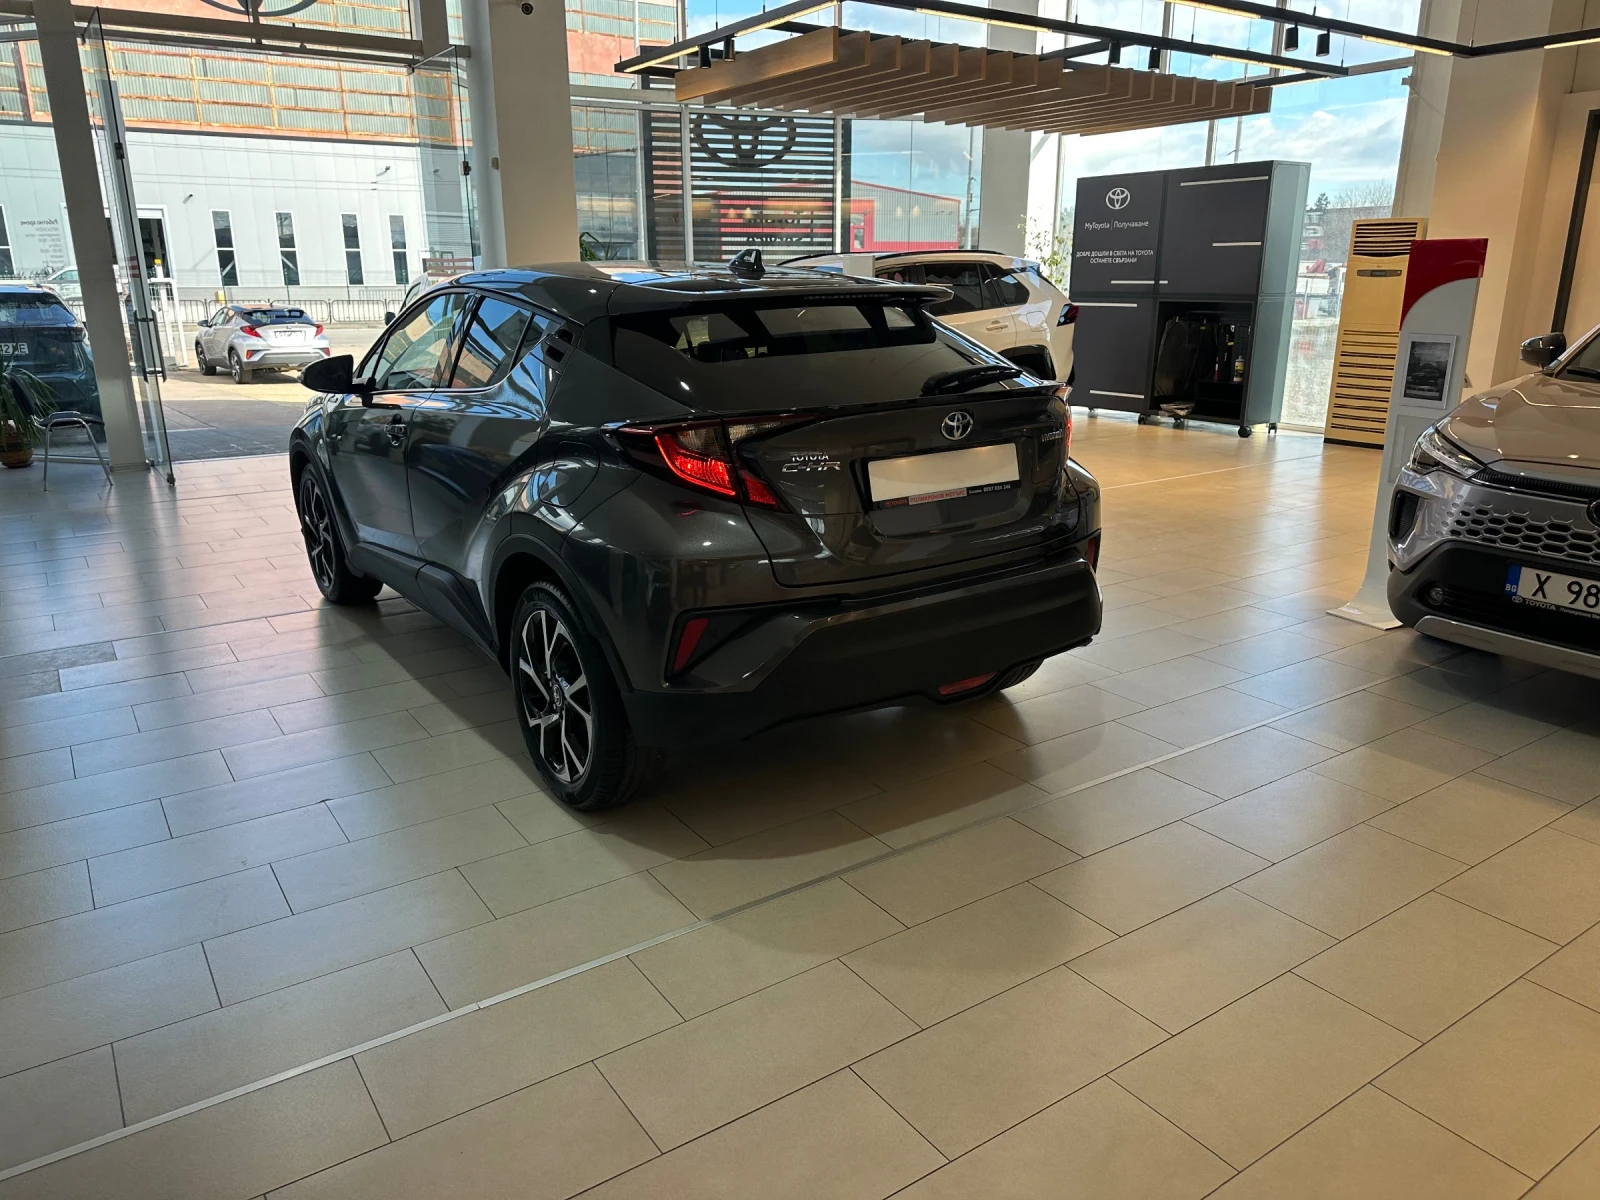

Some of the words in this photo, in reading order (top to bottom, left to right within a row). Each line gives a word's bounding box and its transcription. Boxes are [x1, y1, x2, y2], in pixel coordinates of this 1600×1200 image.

[1084, 222, 1110, 230] MyToyota
[1113, 221, 1149, 229] Получаване
[790, 452, 829, 461] TOYOTA
[782, 461, 841, 472] C-HR
[1505, 583, 1517, 592] BG
[1531, 573, 1552, 599] X
[1525, 599, 1556, 610] TOYOTA
